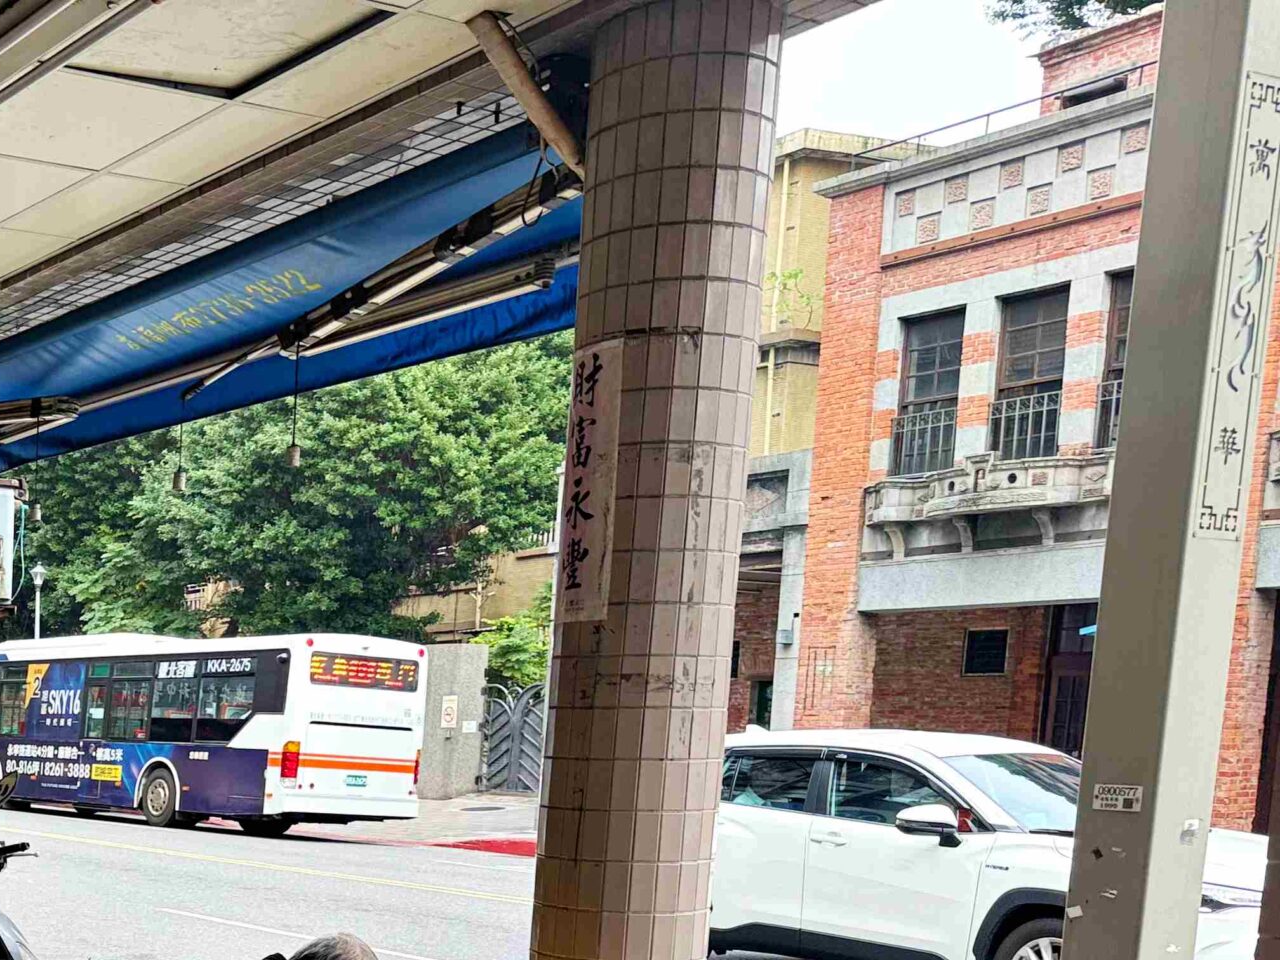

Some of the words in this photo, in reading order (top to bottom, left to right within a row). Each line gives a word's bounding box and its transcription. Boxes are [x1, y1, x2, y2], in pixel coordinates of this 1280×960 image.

[207, 658, 252, 673] KKA-2675
[48, 689, 81, 715] SKY16
[44, 761, 91, 779] 8261-3888
[1098, 786, 1139, 797] 0900577
